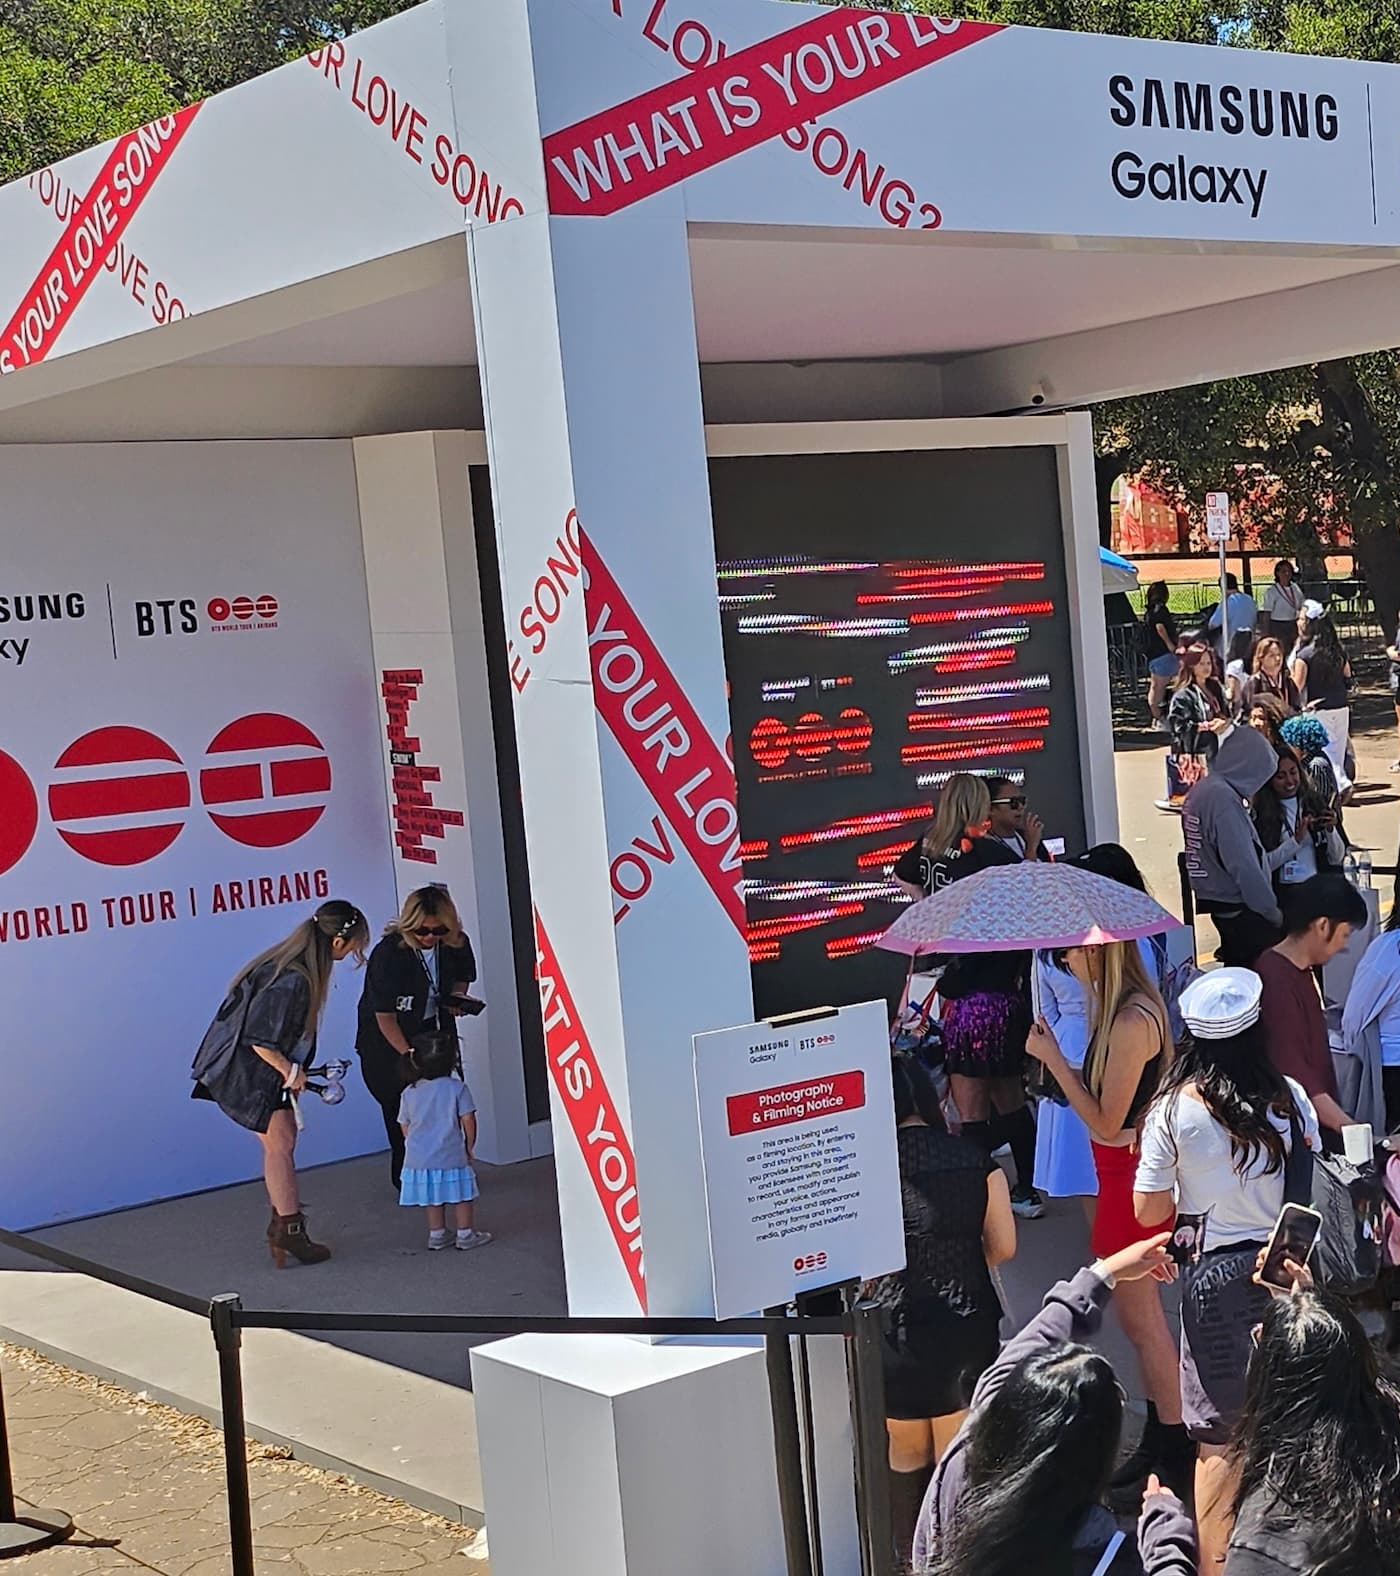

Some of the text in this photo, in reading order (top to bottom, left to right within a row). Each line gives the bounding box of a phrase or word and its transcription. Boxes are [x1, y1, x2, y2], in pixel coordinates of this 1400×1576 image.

[351, 57, 428, 165] LOVE
[551, 12, 963, 202] WHAT IS YOUR LO
[1108, 74, 1339, 142] SAMSUNG
[1111, 151, 1268, 218] Galaxy
[12, 267, 70, 365] YOUR
[63, 184, 119, 289] LOVE
[104, 241, 149, 307] OVE
[0, 592, 85, 623] SUNG
[135, 598, 199, 637] BTS
[588, 603, 746, 906] YOUR LOV
[609, 816, 676, 925] OV
[102, 889, 177, 929] TOUR
[212, 869, 330, 914] ARIRANG
[536, 955, 571, 1032] AT
[556, 1039, 593, 1101] IS
[749, 1038, 815, 1054] SAMSUNG BTS
[749, 1053, 776, 1064] Galaxy
[759, 1082, 834, 1107] Photography
[752, 1096, 843, 1123] & Filming Notice
[763, 1140, 776, 1149] This
[777, 1137, 794, 1146] area
[801, 1129, 821, 1141] being
[822, 1125, 839, 1135] used
[763, 1148, 786, 1158] filming
[827, 1132, 856, 1143] entering
[763, 1168, 789, 1180] provide
[833, 1152, 857, 1163] agents
[777, 1154, 802, 1165] staying
[773, 1174, 805, 1186] licensees
[806, 1170, 821, 1180] with
[822, 1164, 849, 1175] consent
[797, 1180, 821, 1191] modify
[837, 1171, 861, 1183] publish
[751, 1204, 802, 1222] characteristics
[819, 1191, 860, 1207] appearance
[773, 1198, 789, 1208] your
[790, 1212, 810, 1223] forms
[780, 1224, 808, 1238] globally
